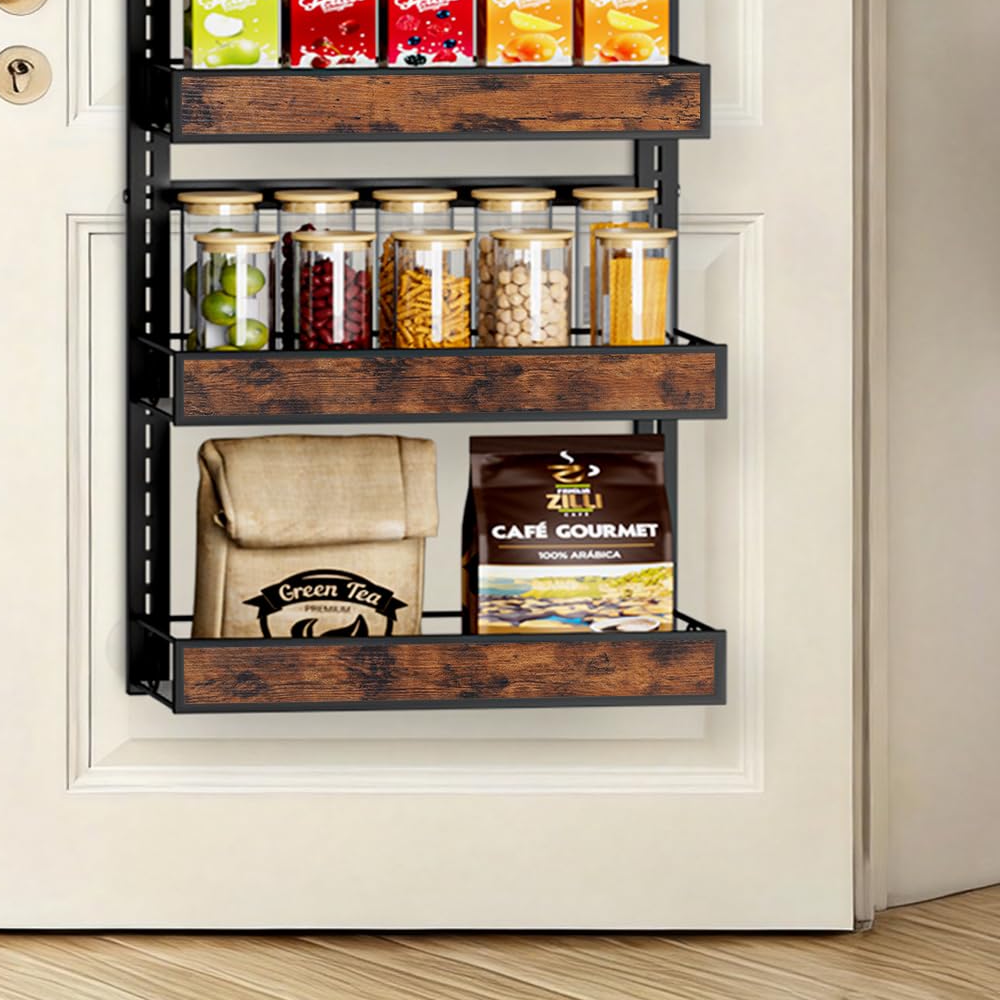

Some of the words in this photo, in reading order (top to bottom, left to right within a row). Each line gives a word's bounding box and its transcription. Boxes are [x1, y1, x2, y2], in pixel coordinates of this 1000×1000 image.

[545, 493, 603, 509] ZILLI
[491, 521, 548, 539] CAFÉ
[556, 523, 658, 539] GOURMET
[538, 551, 568, 560] 100%
[570, 549, 621, 559] ARÁBICA
[279, 584, 338, 602] Green
[347, 582, 382, 605] Tea
[305, 604, 350, 613] PREMIUM
